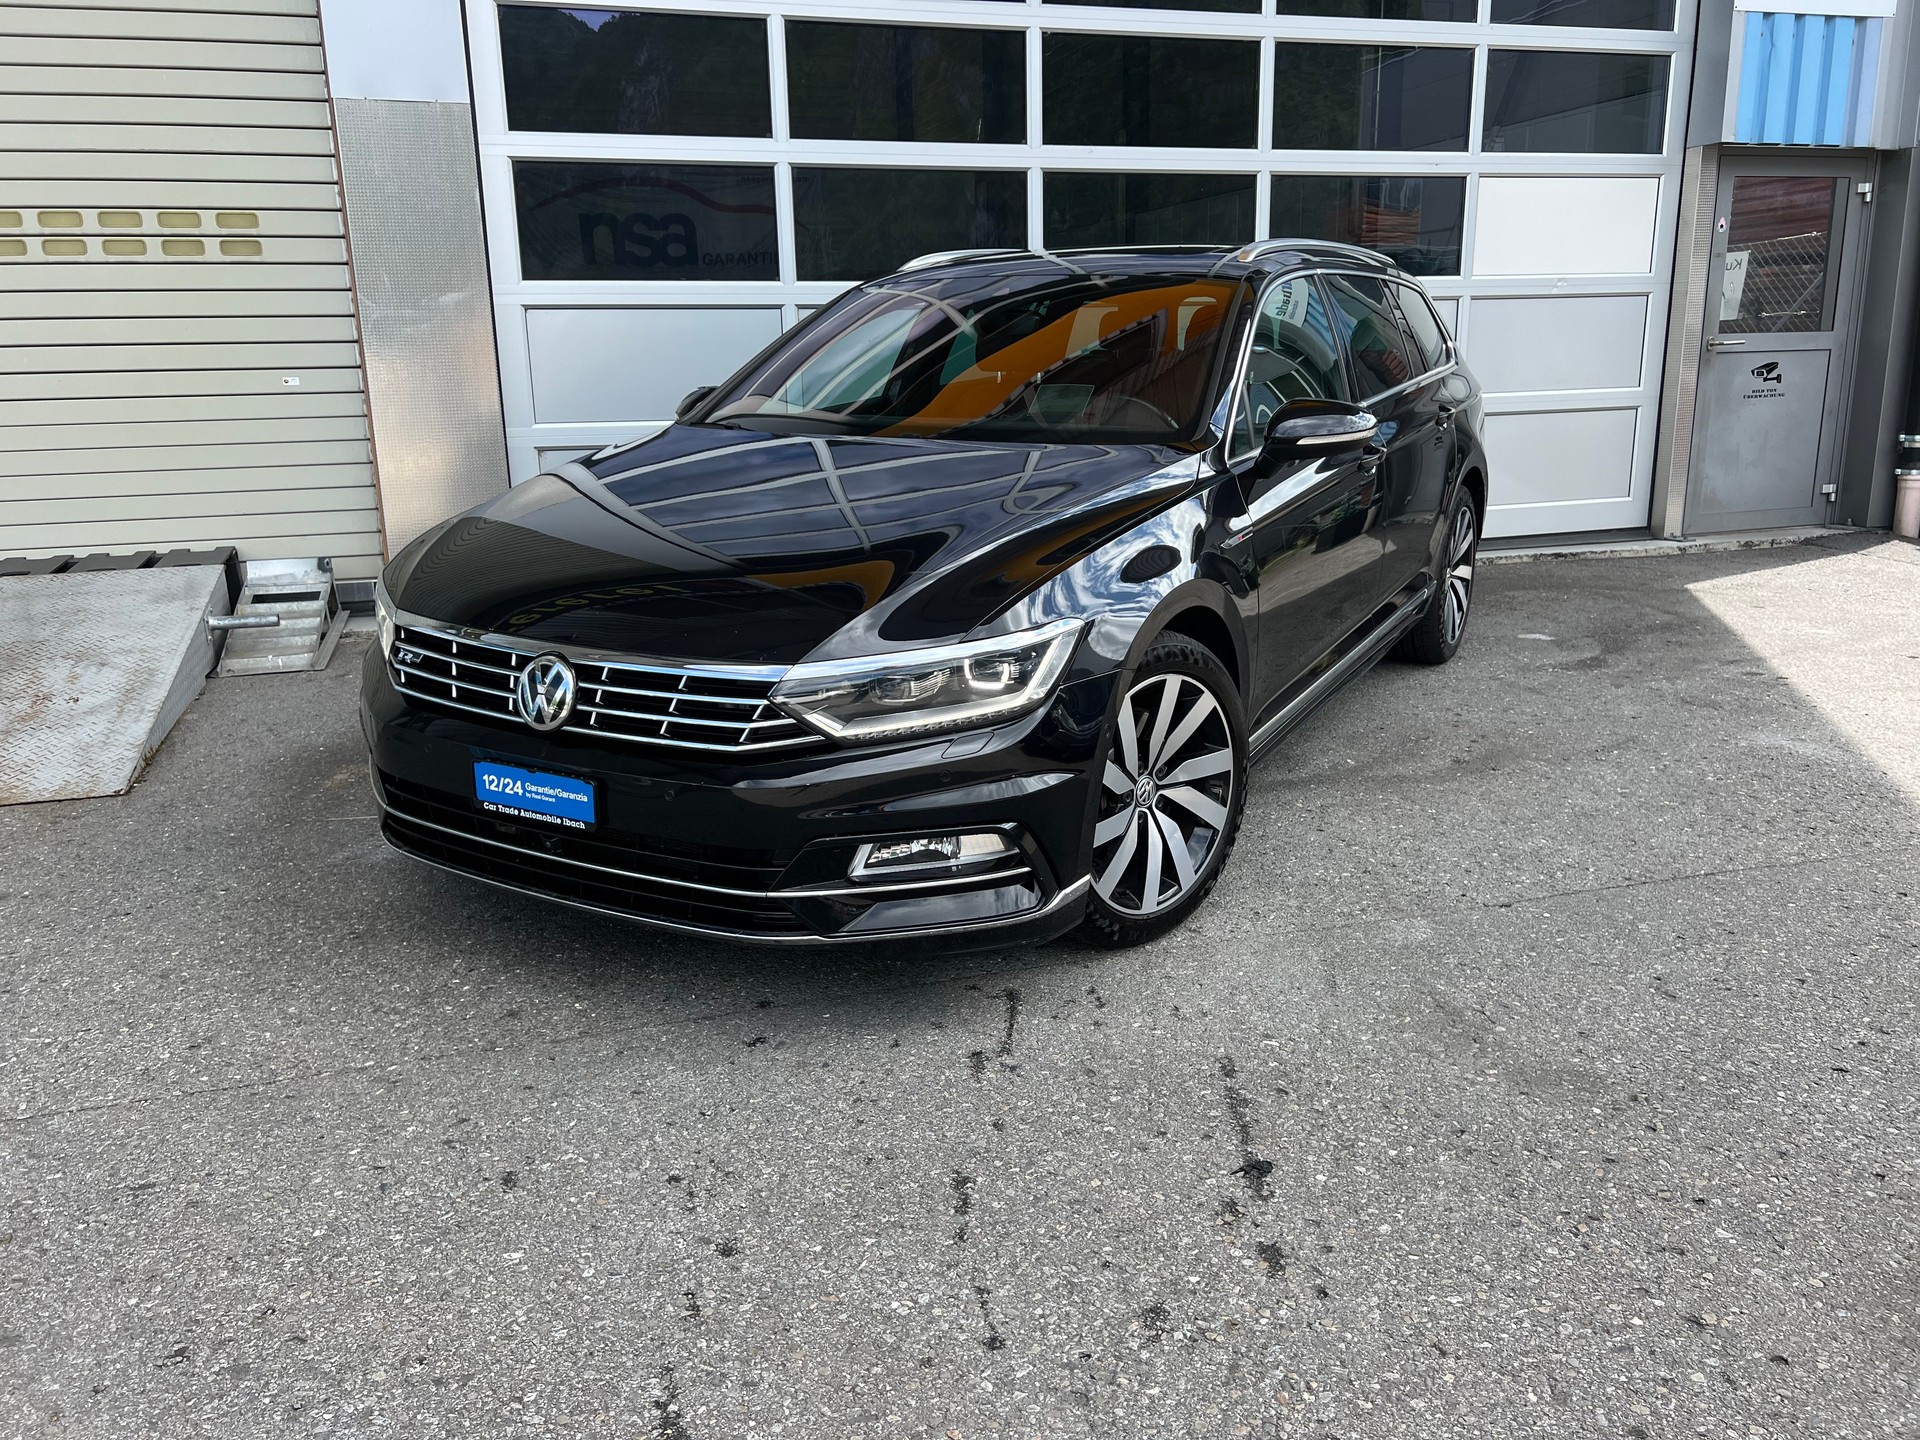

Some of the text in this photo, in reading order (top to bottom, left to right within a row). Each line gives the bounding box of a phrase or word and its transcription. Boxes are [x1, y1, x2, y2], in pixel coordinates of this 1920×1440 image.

[578, 213, 699, 267] nsa
[482, 774, 524, 797] 12/24
[525, 782, 588, 802] Garantie/Garanzia
[483, 802, 586, 830] Car Trade Automobile Ibach
